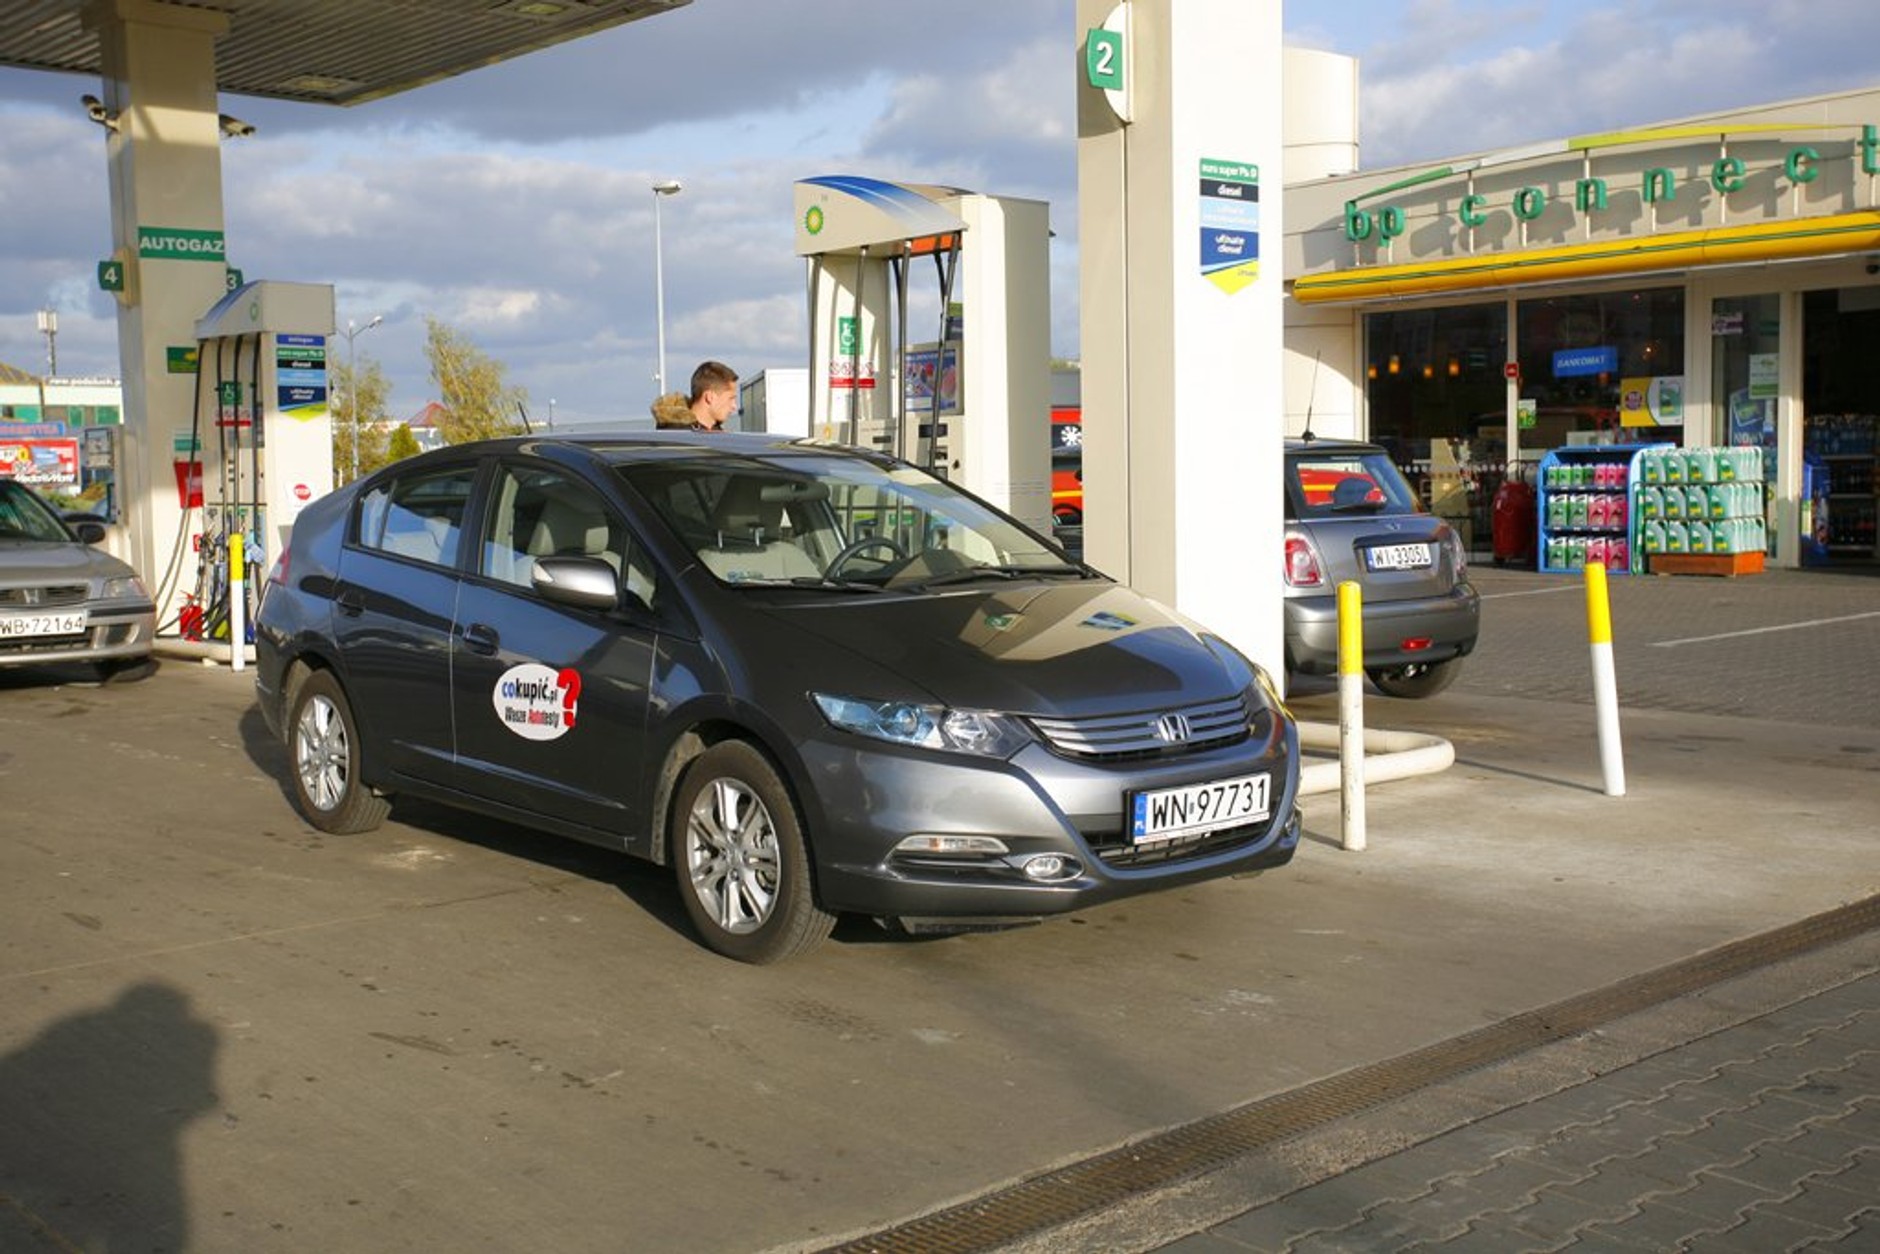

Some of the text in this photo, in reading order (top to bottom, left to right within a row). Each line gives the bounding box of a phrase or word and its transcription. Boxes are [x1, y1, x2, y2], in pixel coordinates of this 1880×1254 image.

[1096, 41, 1114, 75] 2
[1217, 184, 1242, 197] diesel
[1344, 124, 1880, 247] bp connect
[140, 236, 224, 253] AUTOGAZ
[104, 267, 117, 284] 4
[226, 275, 237, 290] 3
[1557, 354, 1605, 369] BANKOMAT
[1374, 549, 1391, 565] WI
[32, 616, 83, 633] 72164
[501, 677, 558, 706] cokupić.pl
[505, 706, 527, 723] Wasze
[1152, 793, 1188, 829] WN
[1197, 778, 1266, 822] 97731
